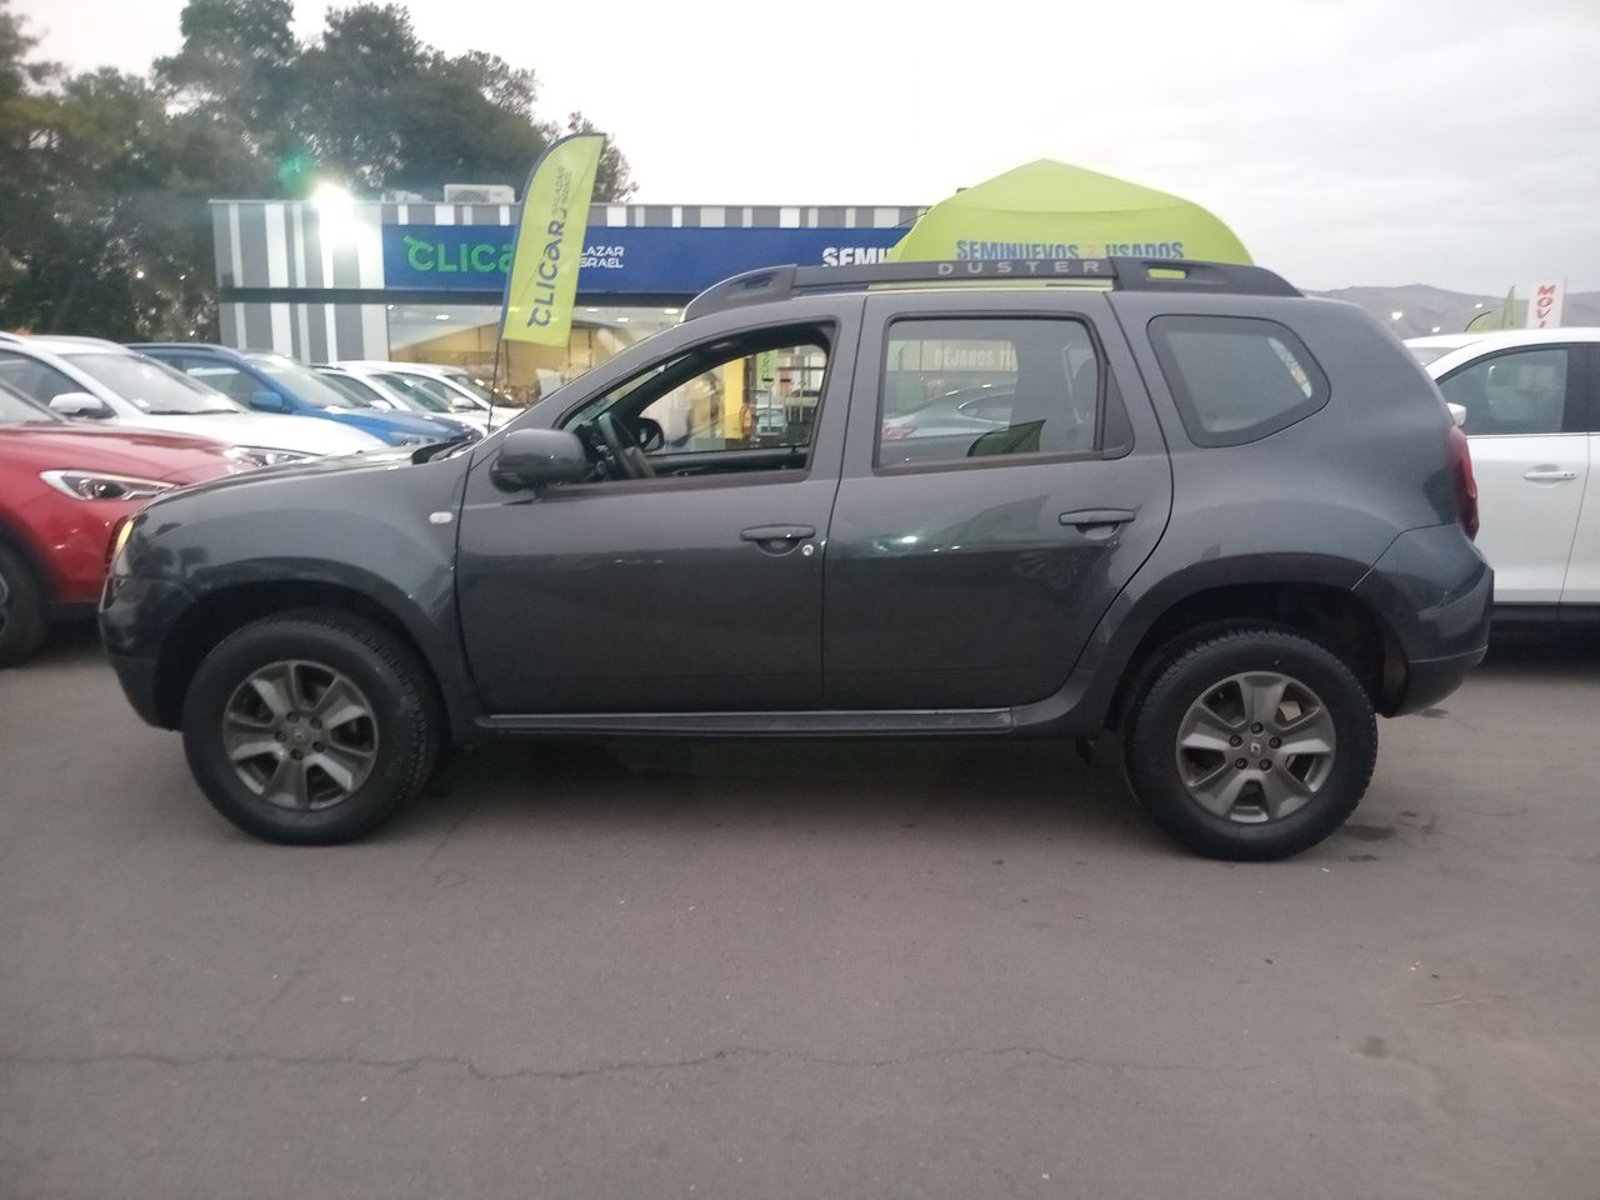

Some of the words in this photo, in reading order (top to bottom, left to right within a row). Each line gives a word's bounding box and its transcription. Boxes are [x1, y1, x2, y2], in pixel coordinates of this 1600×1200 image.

[956, 240, 1080, 259] SEMINUEVOS
[1105, 241, 1185, 258] USADOS
[938, 260, 1100, 275] DUSTER
